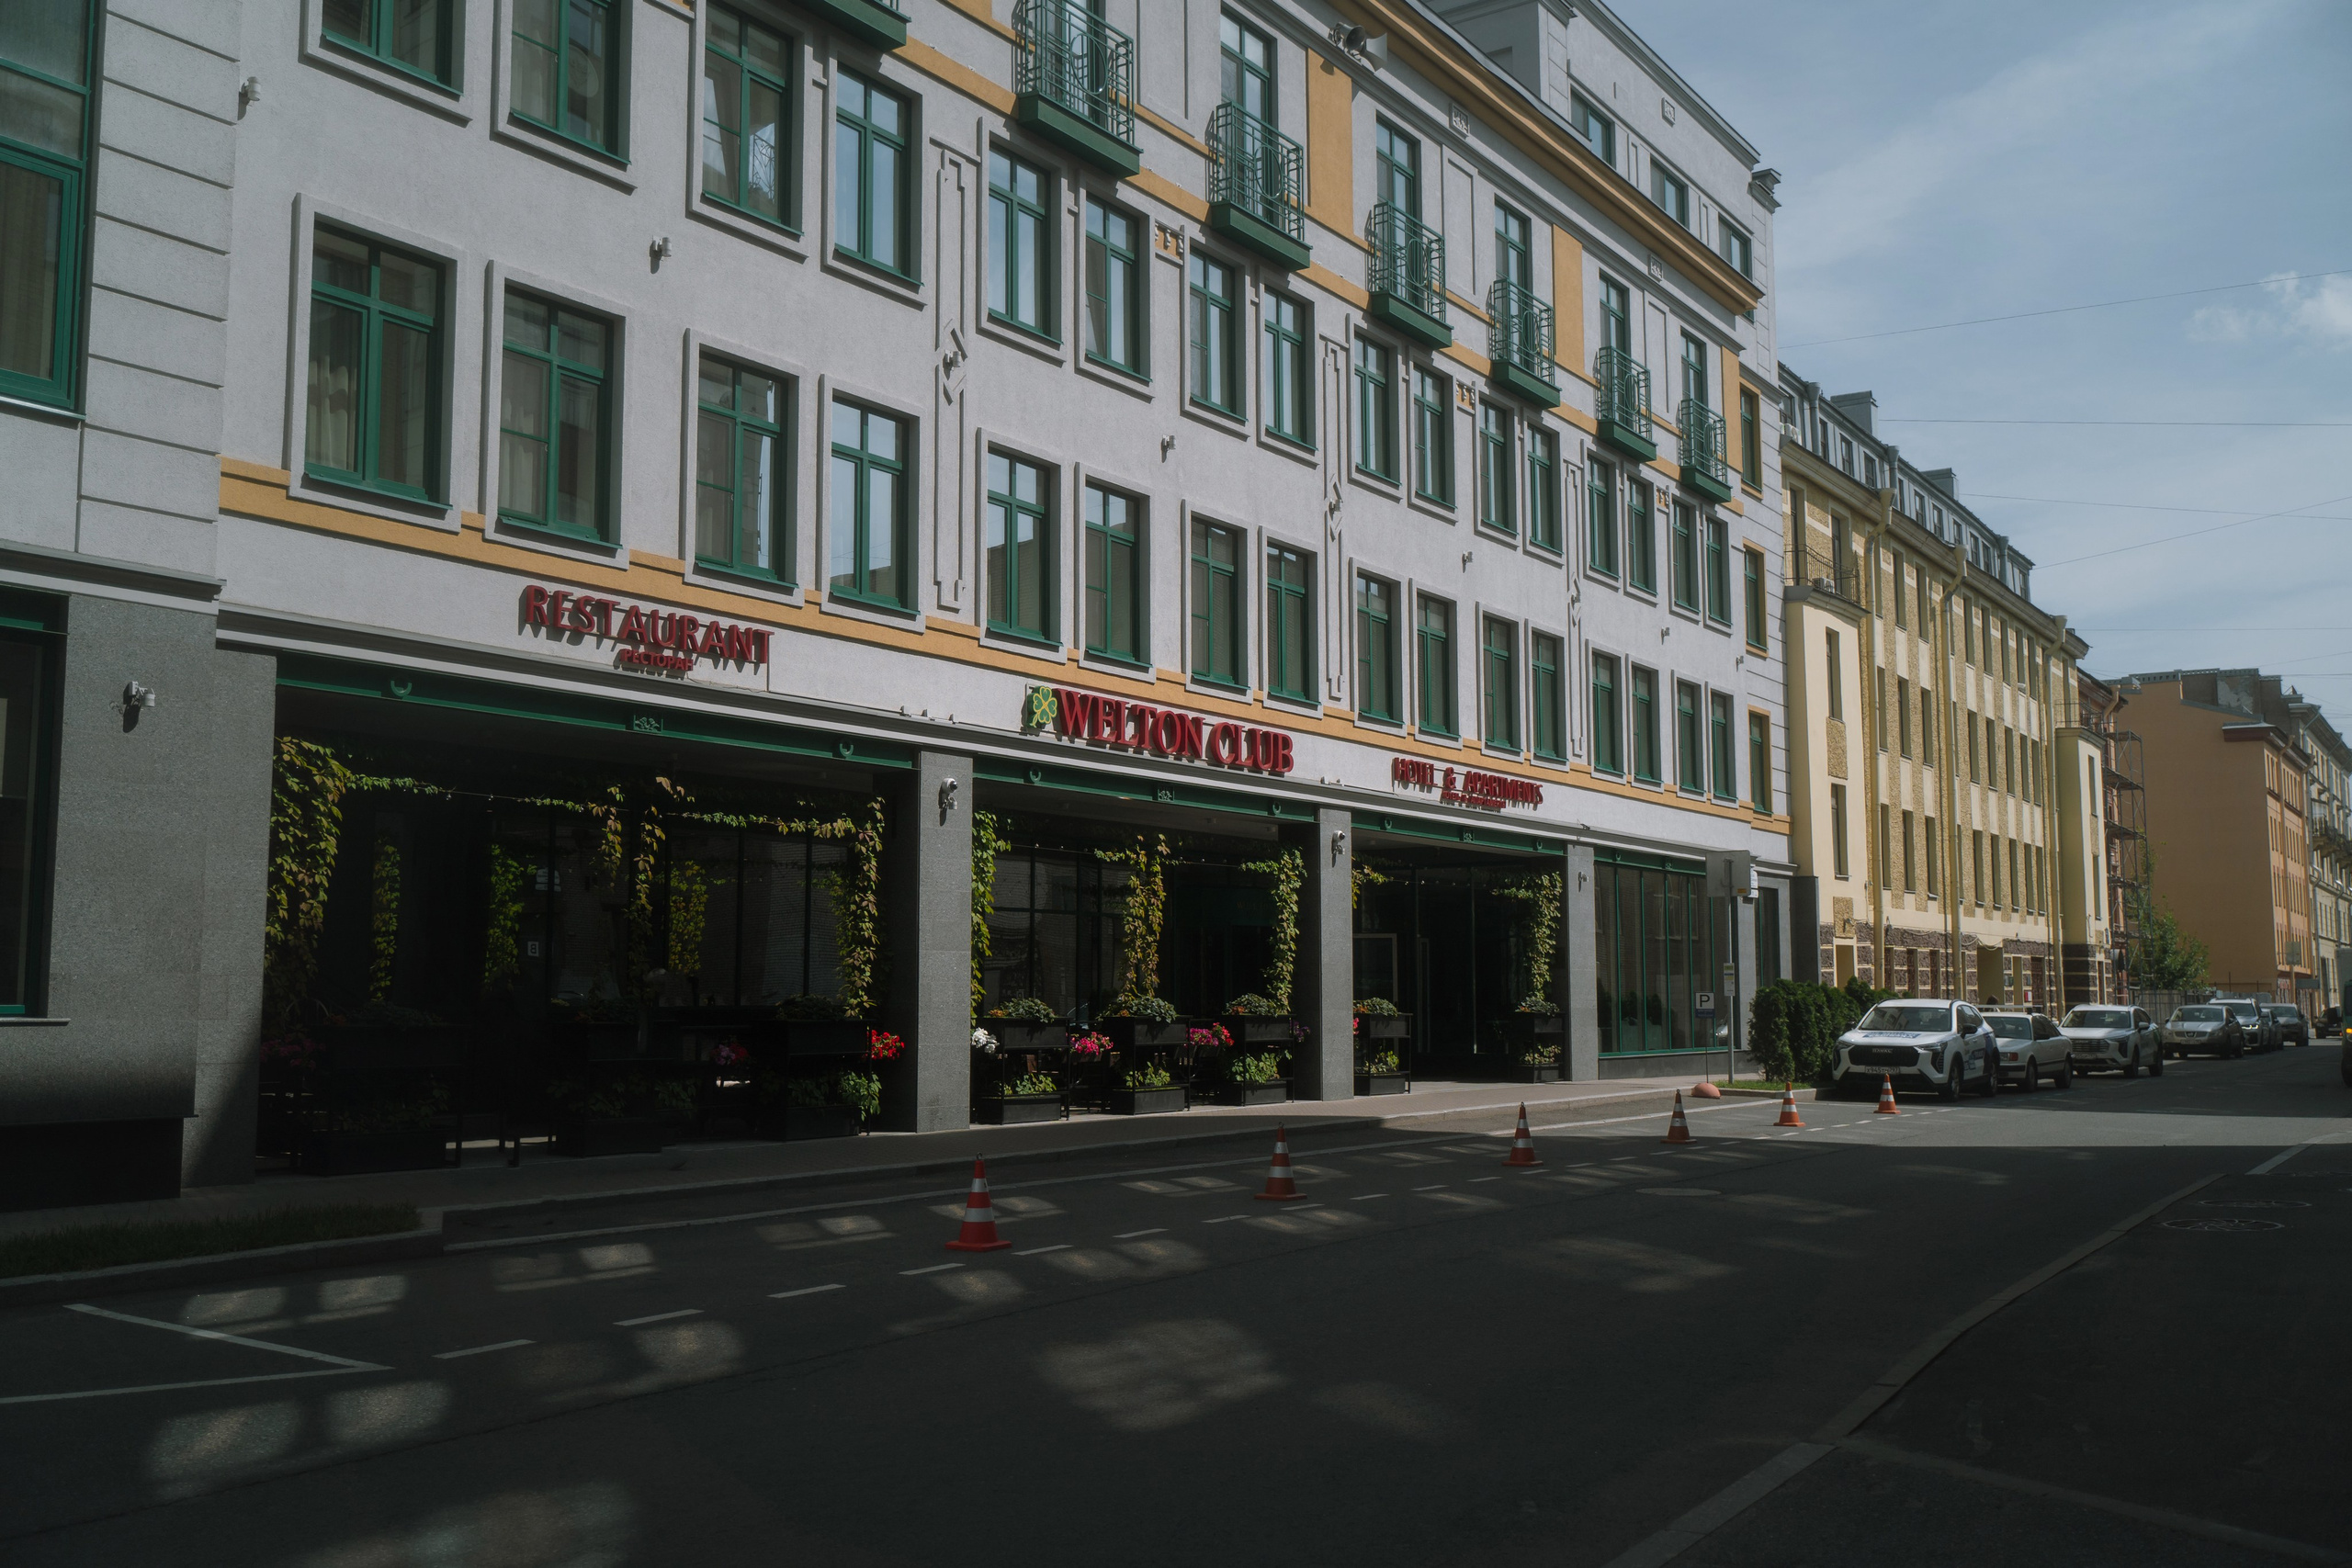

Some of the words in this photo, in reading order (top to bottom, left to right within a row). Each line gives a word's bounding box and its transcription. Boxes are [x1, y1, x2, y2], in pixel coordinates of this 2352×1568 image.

[526, 585, 775, 663] RESTAURANT
[620, 649, 694, 671] РЕСТОРАН
[1053, 688, 1205, 759] WELTON
[1210, 722, 1294, 773] CLUB
[1394, 757, 1438, 786] HOTEL
[1444, 767, 1456, 789] &
[1463, 771, 1544, 805] APARTMENTS
[1700, 994, 1710, 1008] P
